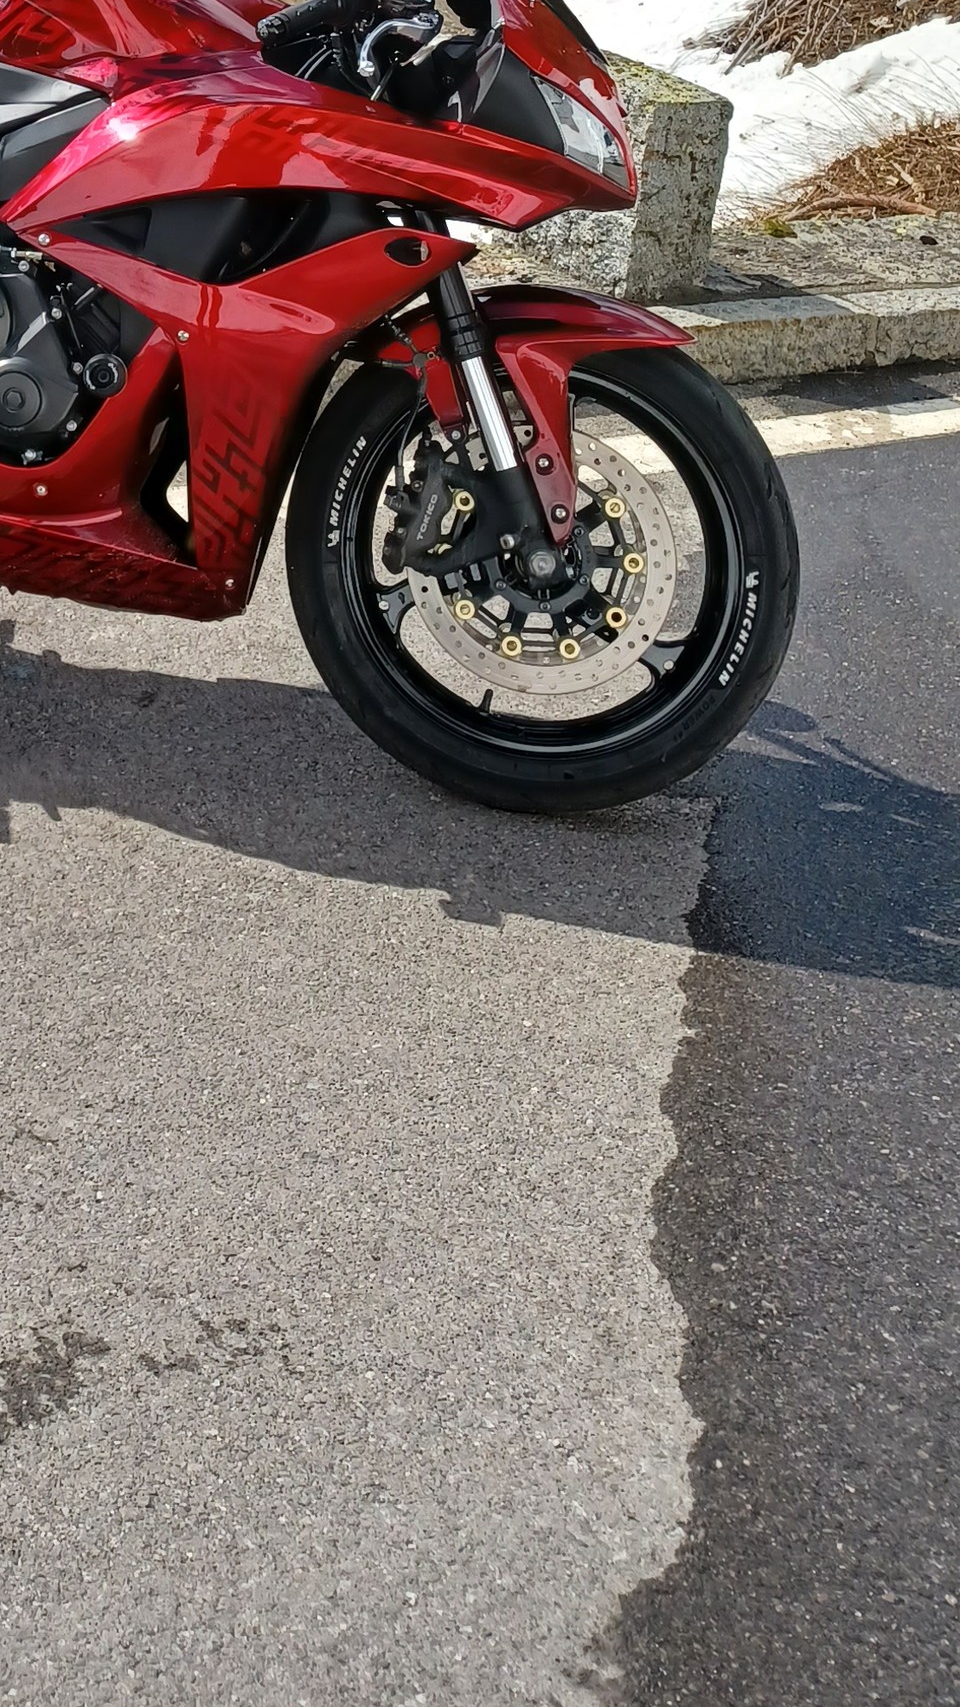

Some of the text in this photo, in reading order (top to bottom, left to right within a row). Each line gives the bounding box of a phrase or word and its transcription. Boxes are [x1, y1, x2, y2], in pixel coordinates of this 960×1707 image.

[328, 436, 367, 527] MICHELIN
[416, 494, 439, 542] TOKICO
[717, 591, 759, 687] MICHELIN
